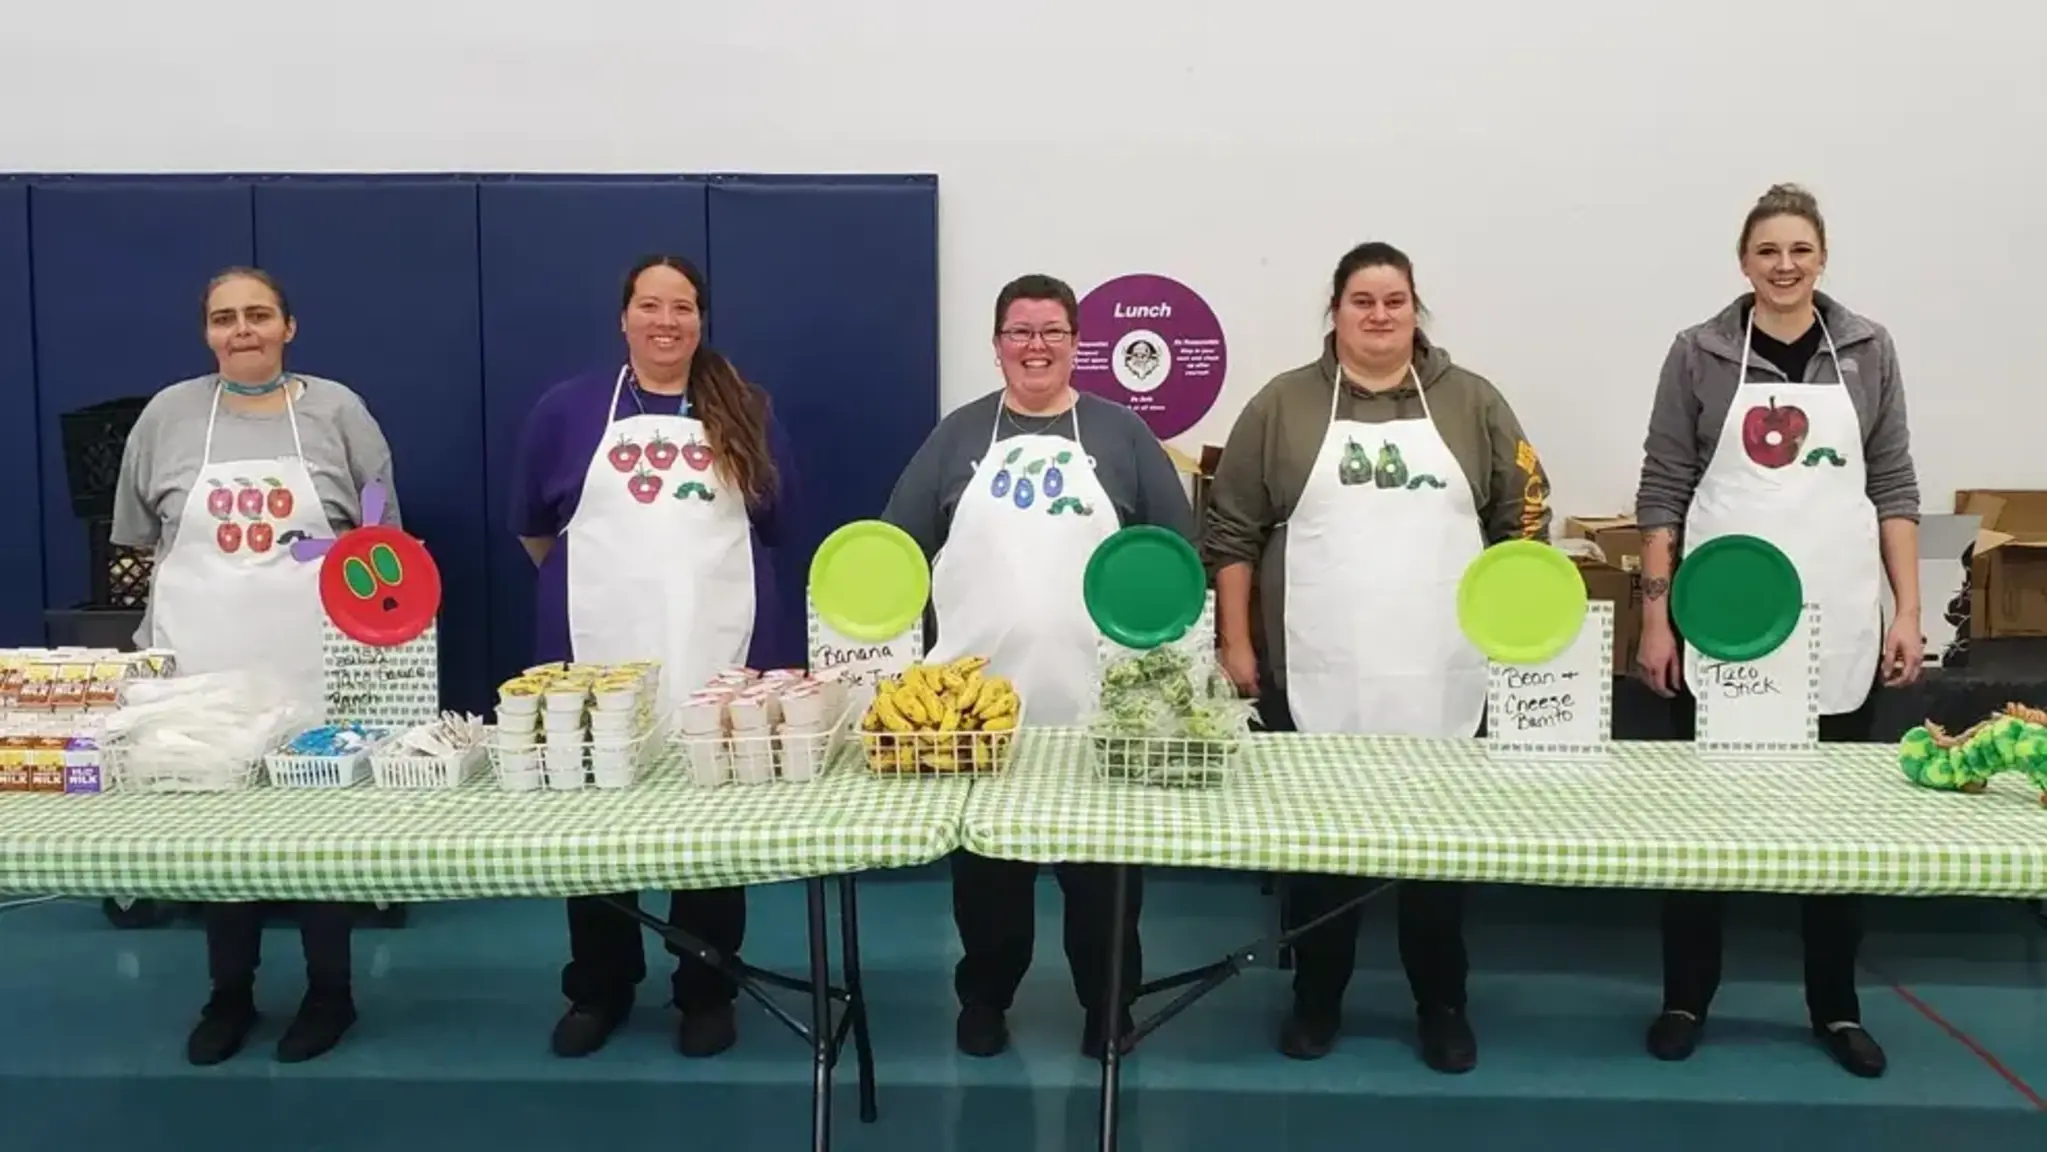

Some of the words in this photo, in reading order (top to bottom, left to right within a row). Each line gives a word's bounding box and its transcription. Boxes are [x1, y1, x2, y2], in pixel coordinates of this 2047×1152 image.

[1113, 301, 1172, 319] Lunch
[817, 644, 893, 666] Banana
[1502, 667, 1556, 689] Bean
[1707, 661, 1759, 684] Taco
[1722, 676, 1781, 699] Stick
[1504, 692, 1576, 715] Cheese
